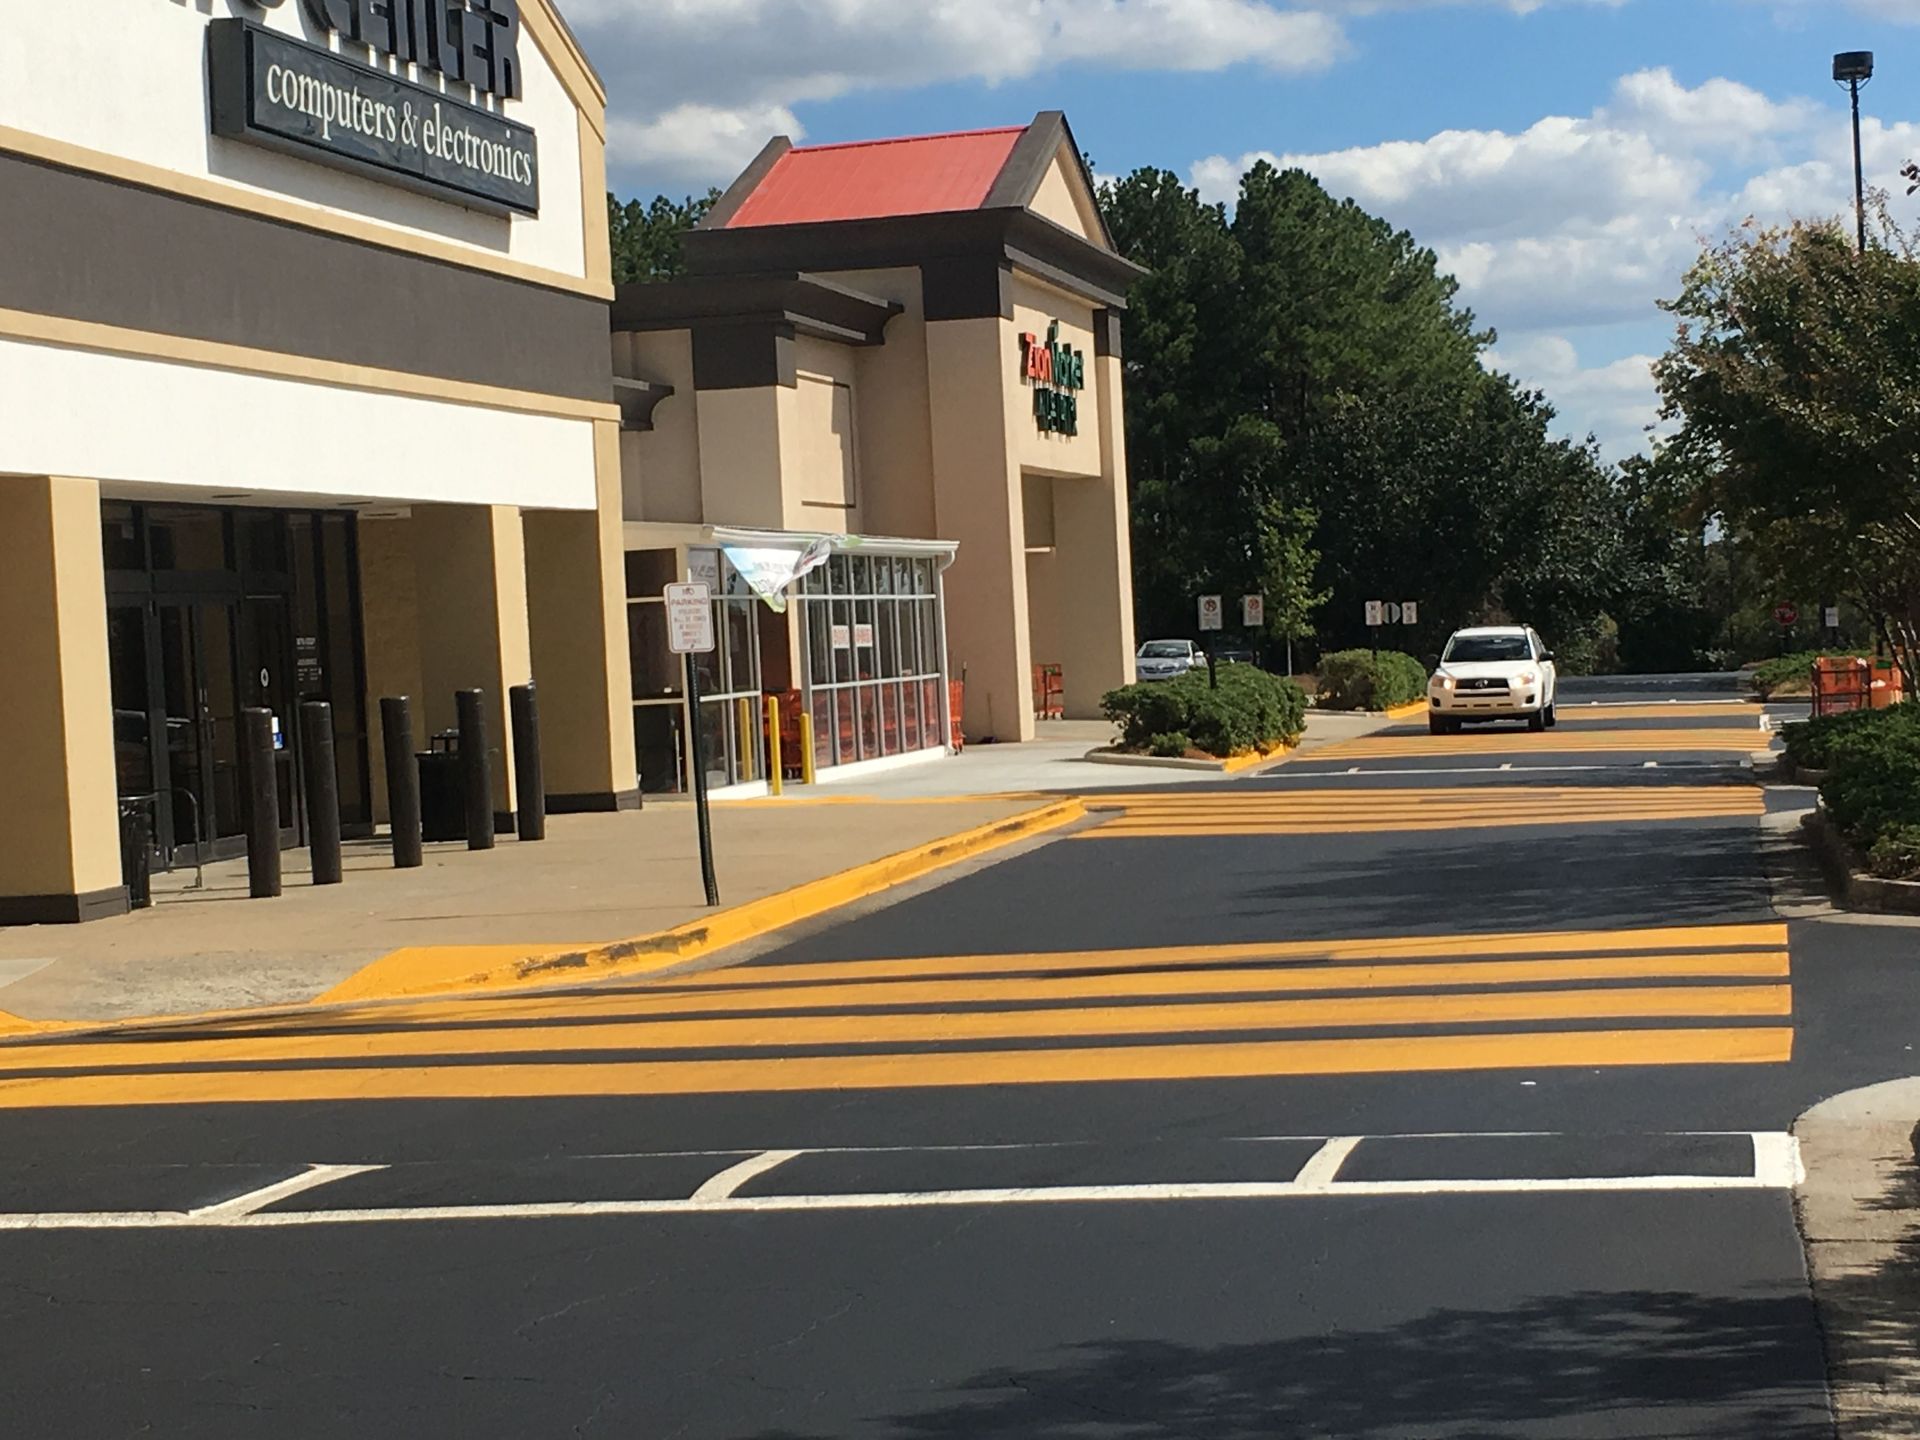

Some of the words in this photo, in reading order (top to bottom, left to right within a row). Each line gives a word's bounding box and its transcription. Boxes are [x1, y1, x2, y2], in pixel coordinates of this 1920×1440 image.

[266, 63, 396, 142] computers
[401, 100, 419, 149] &
[423, 102, 532, 187] electronics
[671, 598, 708, 606] PARKING
